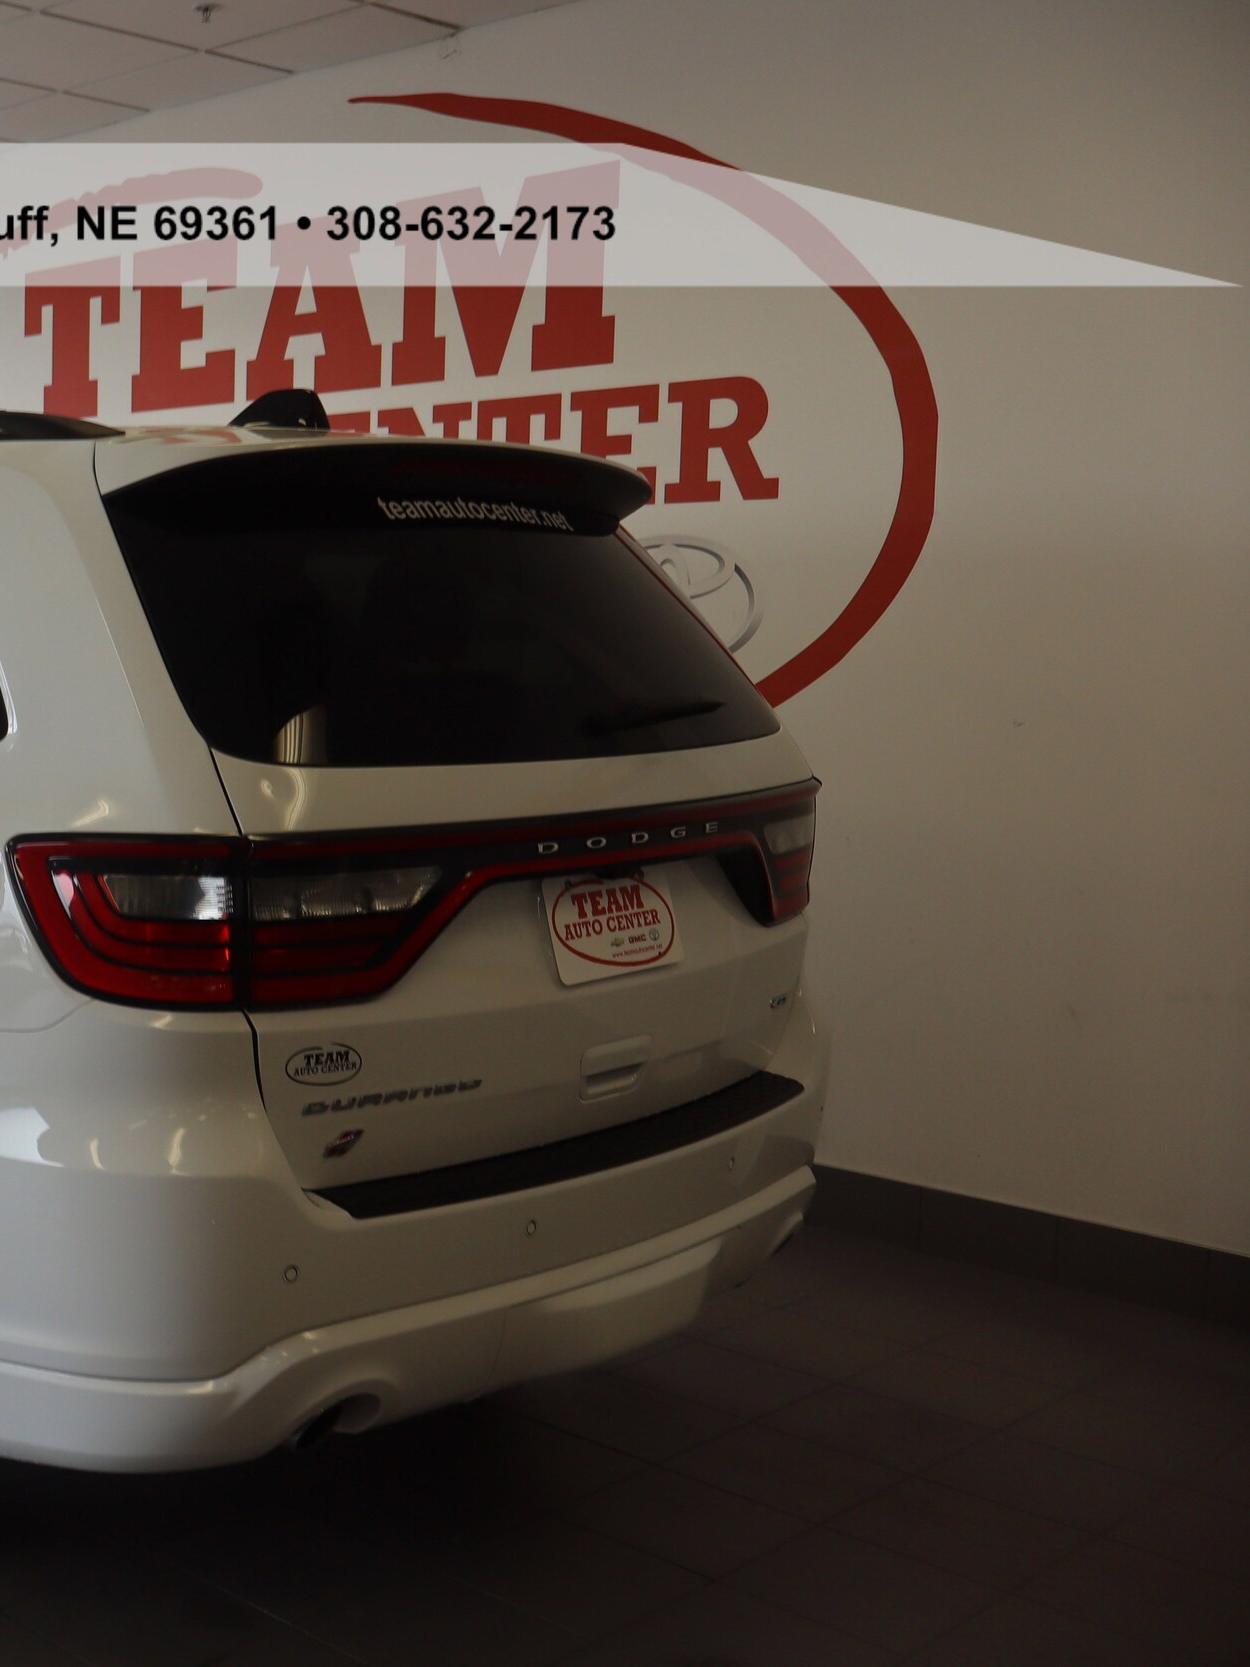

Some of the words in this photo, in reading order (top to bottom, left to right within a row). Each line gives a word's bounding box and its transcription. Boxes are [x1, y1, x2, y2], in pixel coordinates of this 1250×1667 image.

[24, 159, 621, 419] TEAM
[377, 496, 574, 532] teamautocenter.net
[537, 821, 719, 854] DODGE
[571, 884, 645, 919] TEAM
[564, 918, 604, 941] AUTO
[606, 908, 661, 932] CENTER
[628, 934, 647, 944] GMC
[294, 1067, 319, 1077] AUTO
[321, 1061, 357, 1073] CENTER
[304, 1051, 350, 1067] TEAM
[302, 1079, 483, 1116] DURANGO
